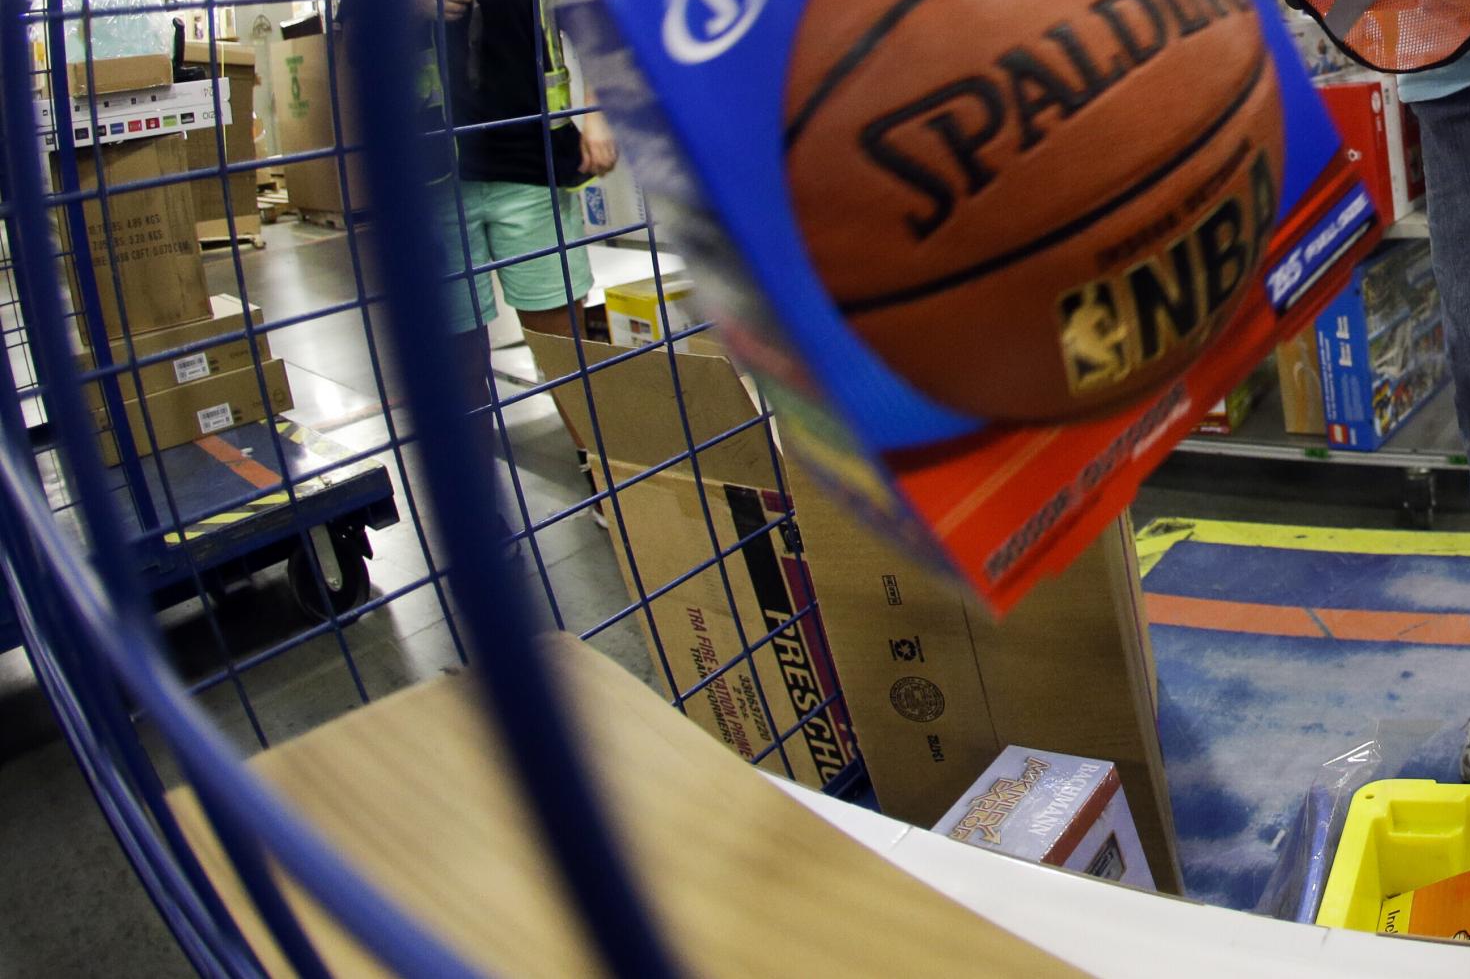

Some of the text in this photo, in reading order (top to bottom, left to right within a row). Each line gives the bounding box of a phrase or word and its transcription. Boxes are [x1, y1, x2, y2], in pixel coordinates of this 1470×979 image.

[696, 634, 719, 666] FIRE
[689, 647, 734, 745] TRANFORMERS
[1027, 762, 1100, 837] BACHMANN
